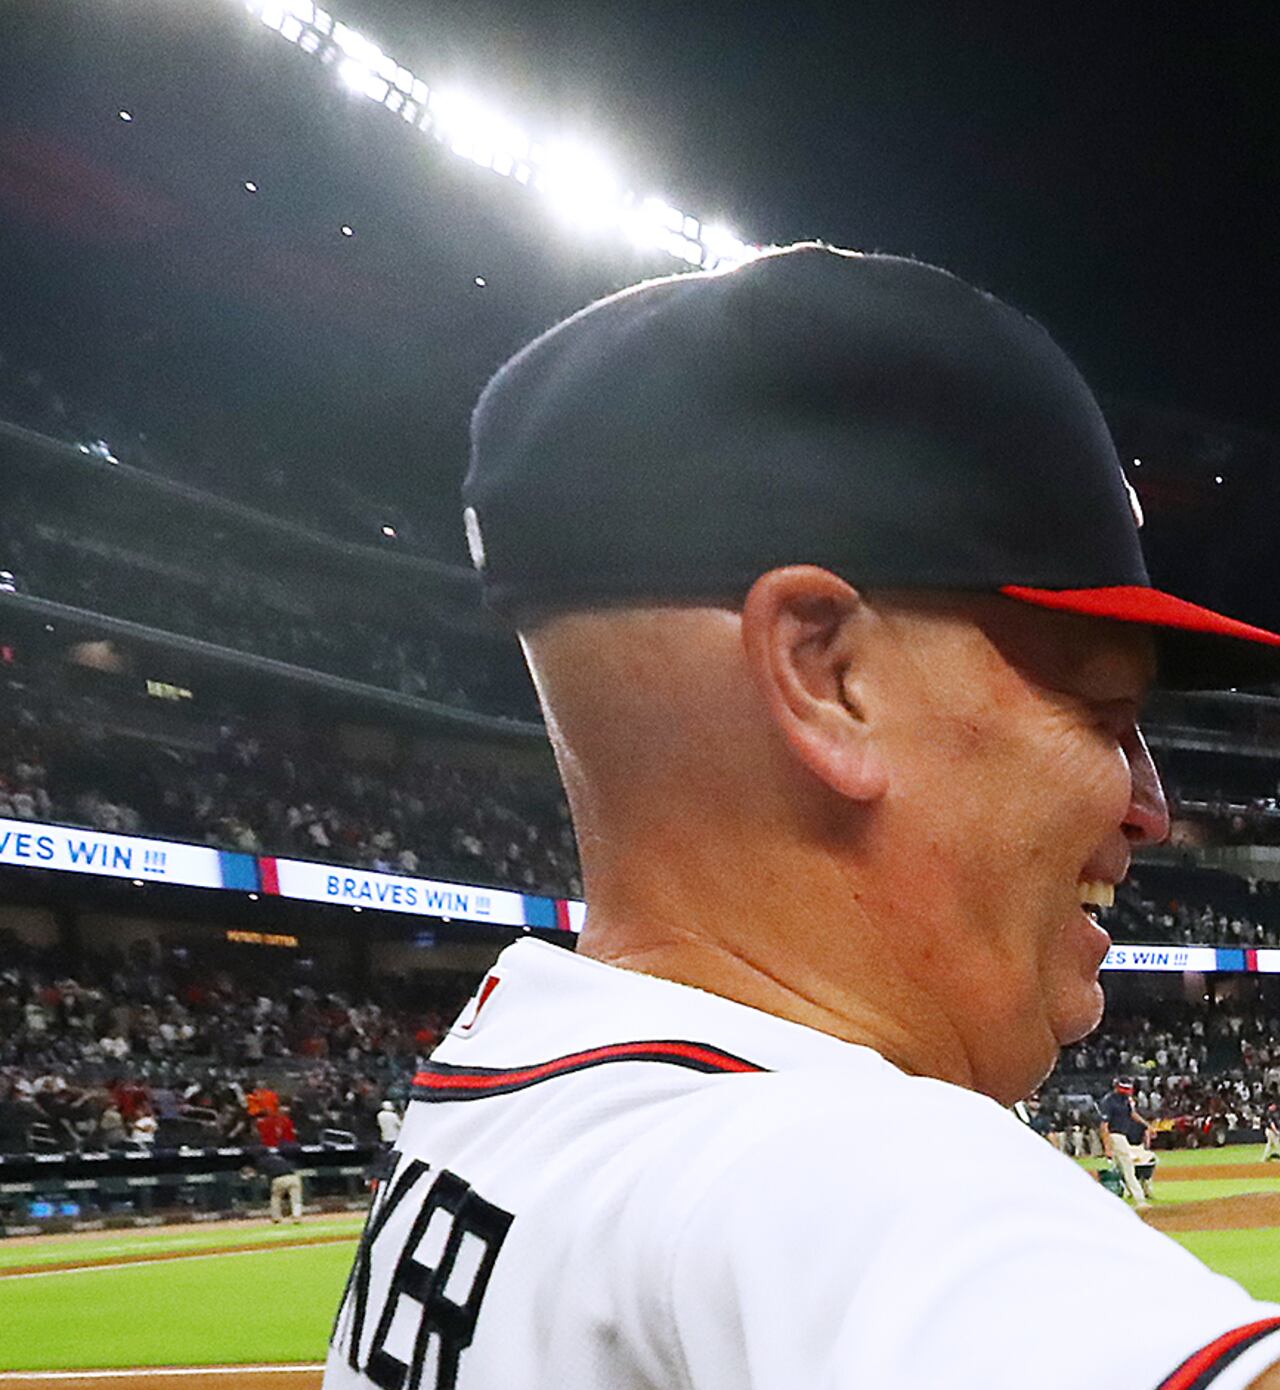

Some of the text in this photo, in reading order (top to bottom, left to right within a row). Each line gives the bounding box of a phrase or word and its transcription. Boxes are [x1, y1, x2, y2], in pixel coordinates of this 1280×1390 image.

[67, 838, 133, 870] WIN
[326, 875, 418, 906] BRAVES
[424, 889, 469, 914] WIN
[1132, 951, 1169, 966] WIN
